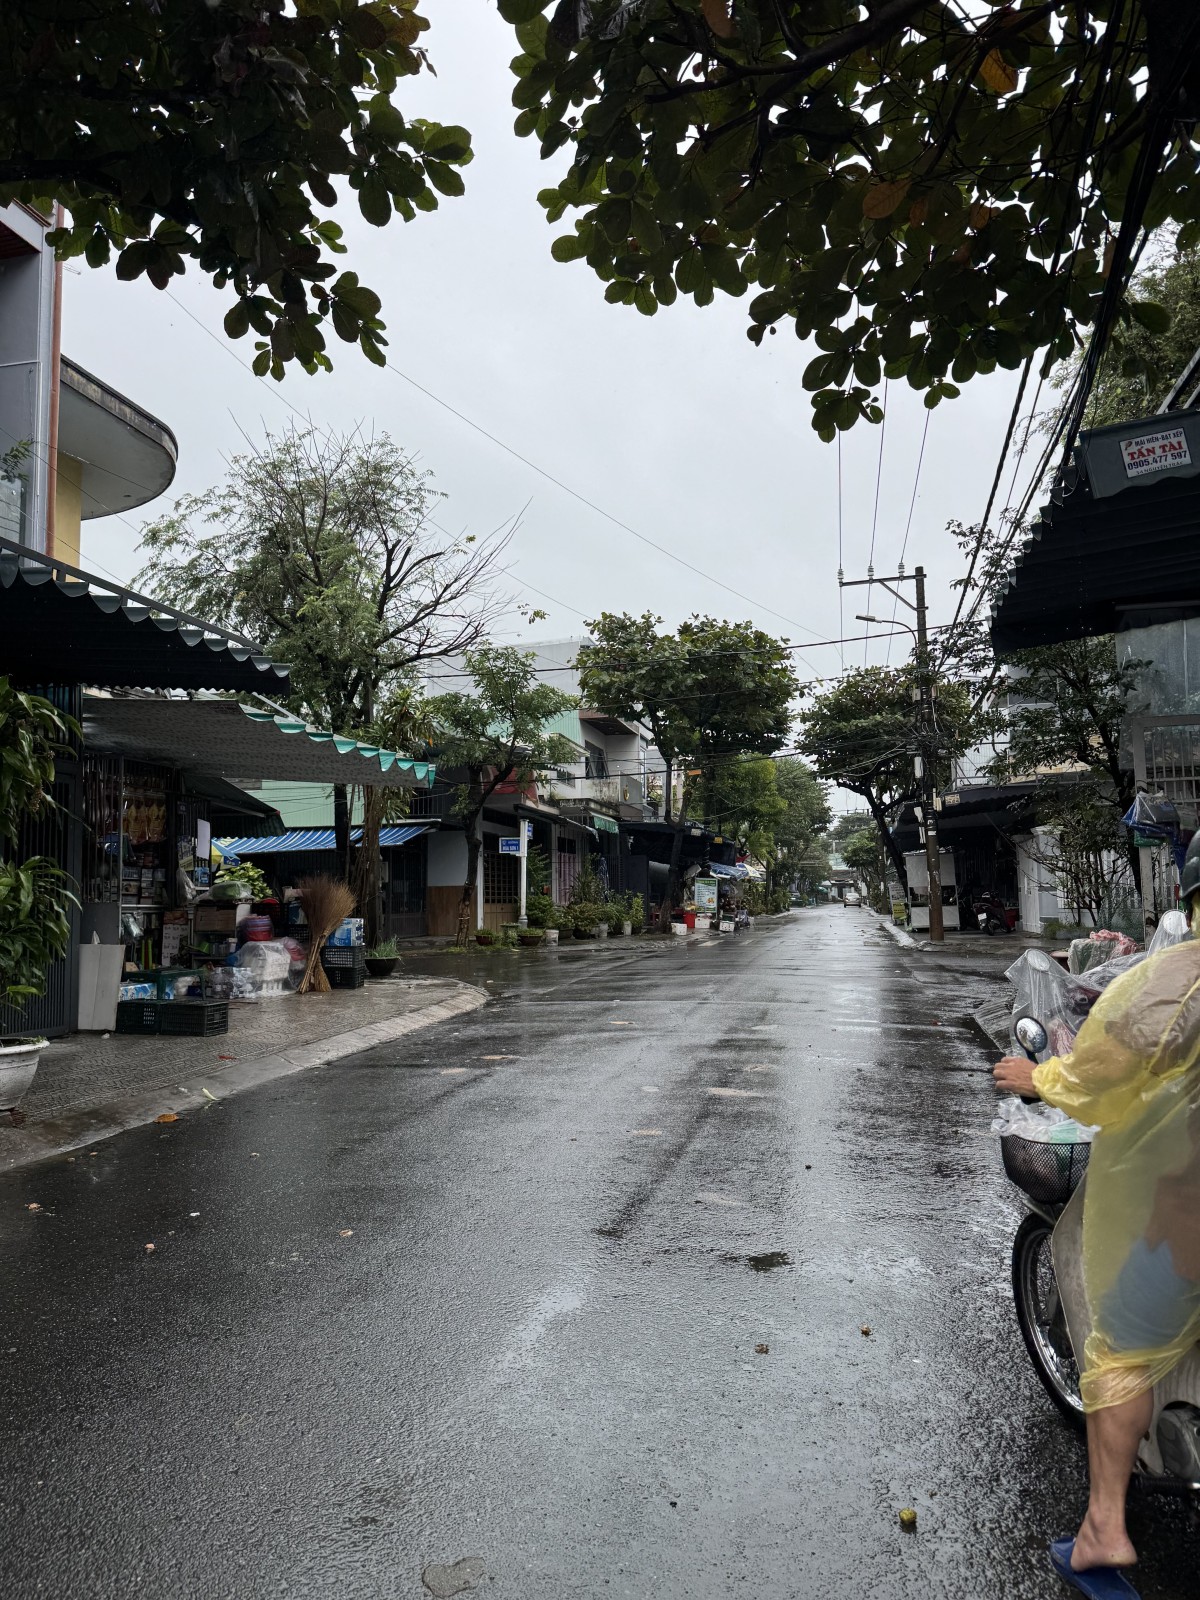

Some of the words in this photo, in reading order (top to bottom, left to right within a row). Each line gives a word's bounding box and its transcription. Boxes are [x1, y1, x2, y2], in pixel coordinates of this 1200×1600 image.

[1159, 441, 1183, 453] TÀI
[1127, 454, 1168, 470] 0905.477
[1171, 450, 1187, 460] 597
